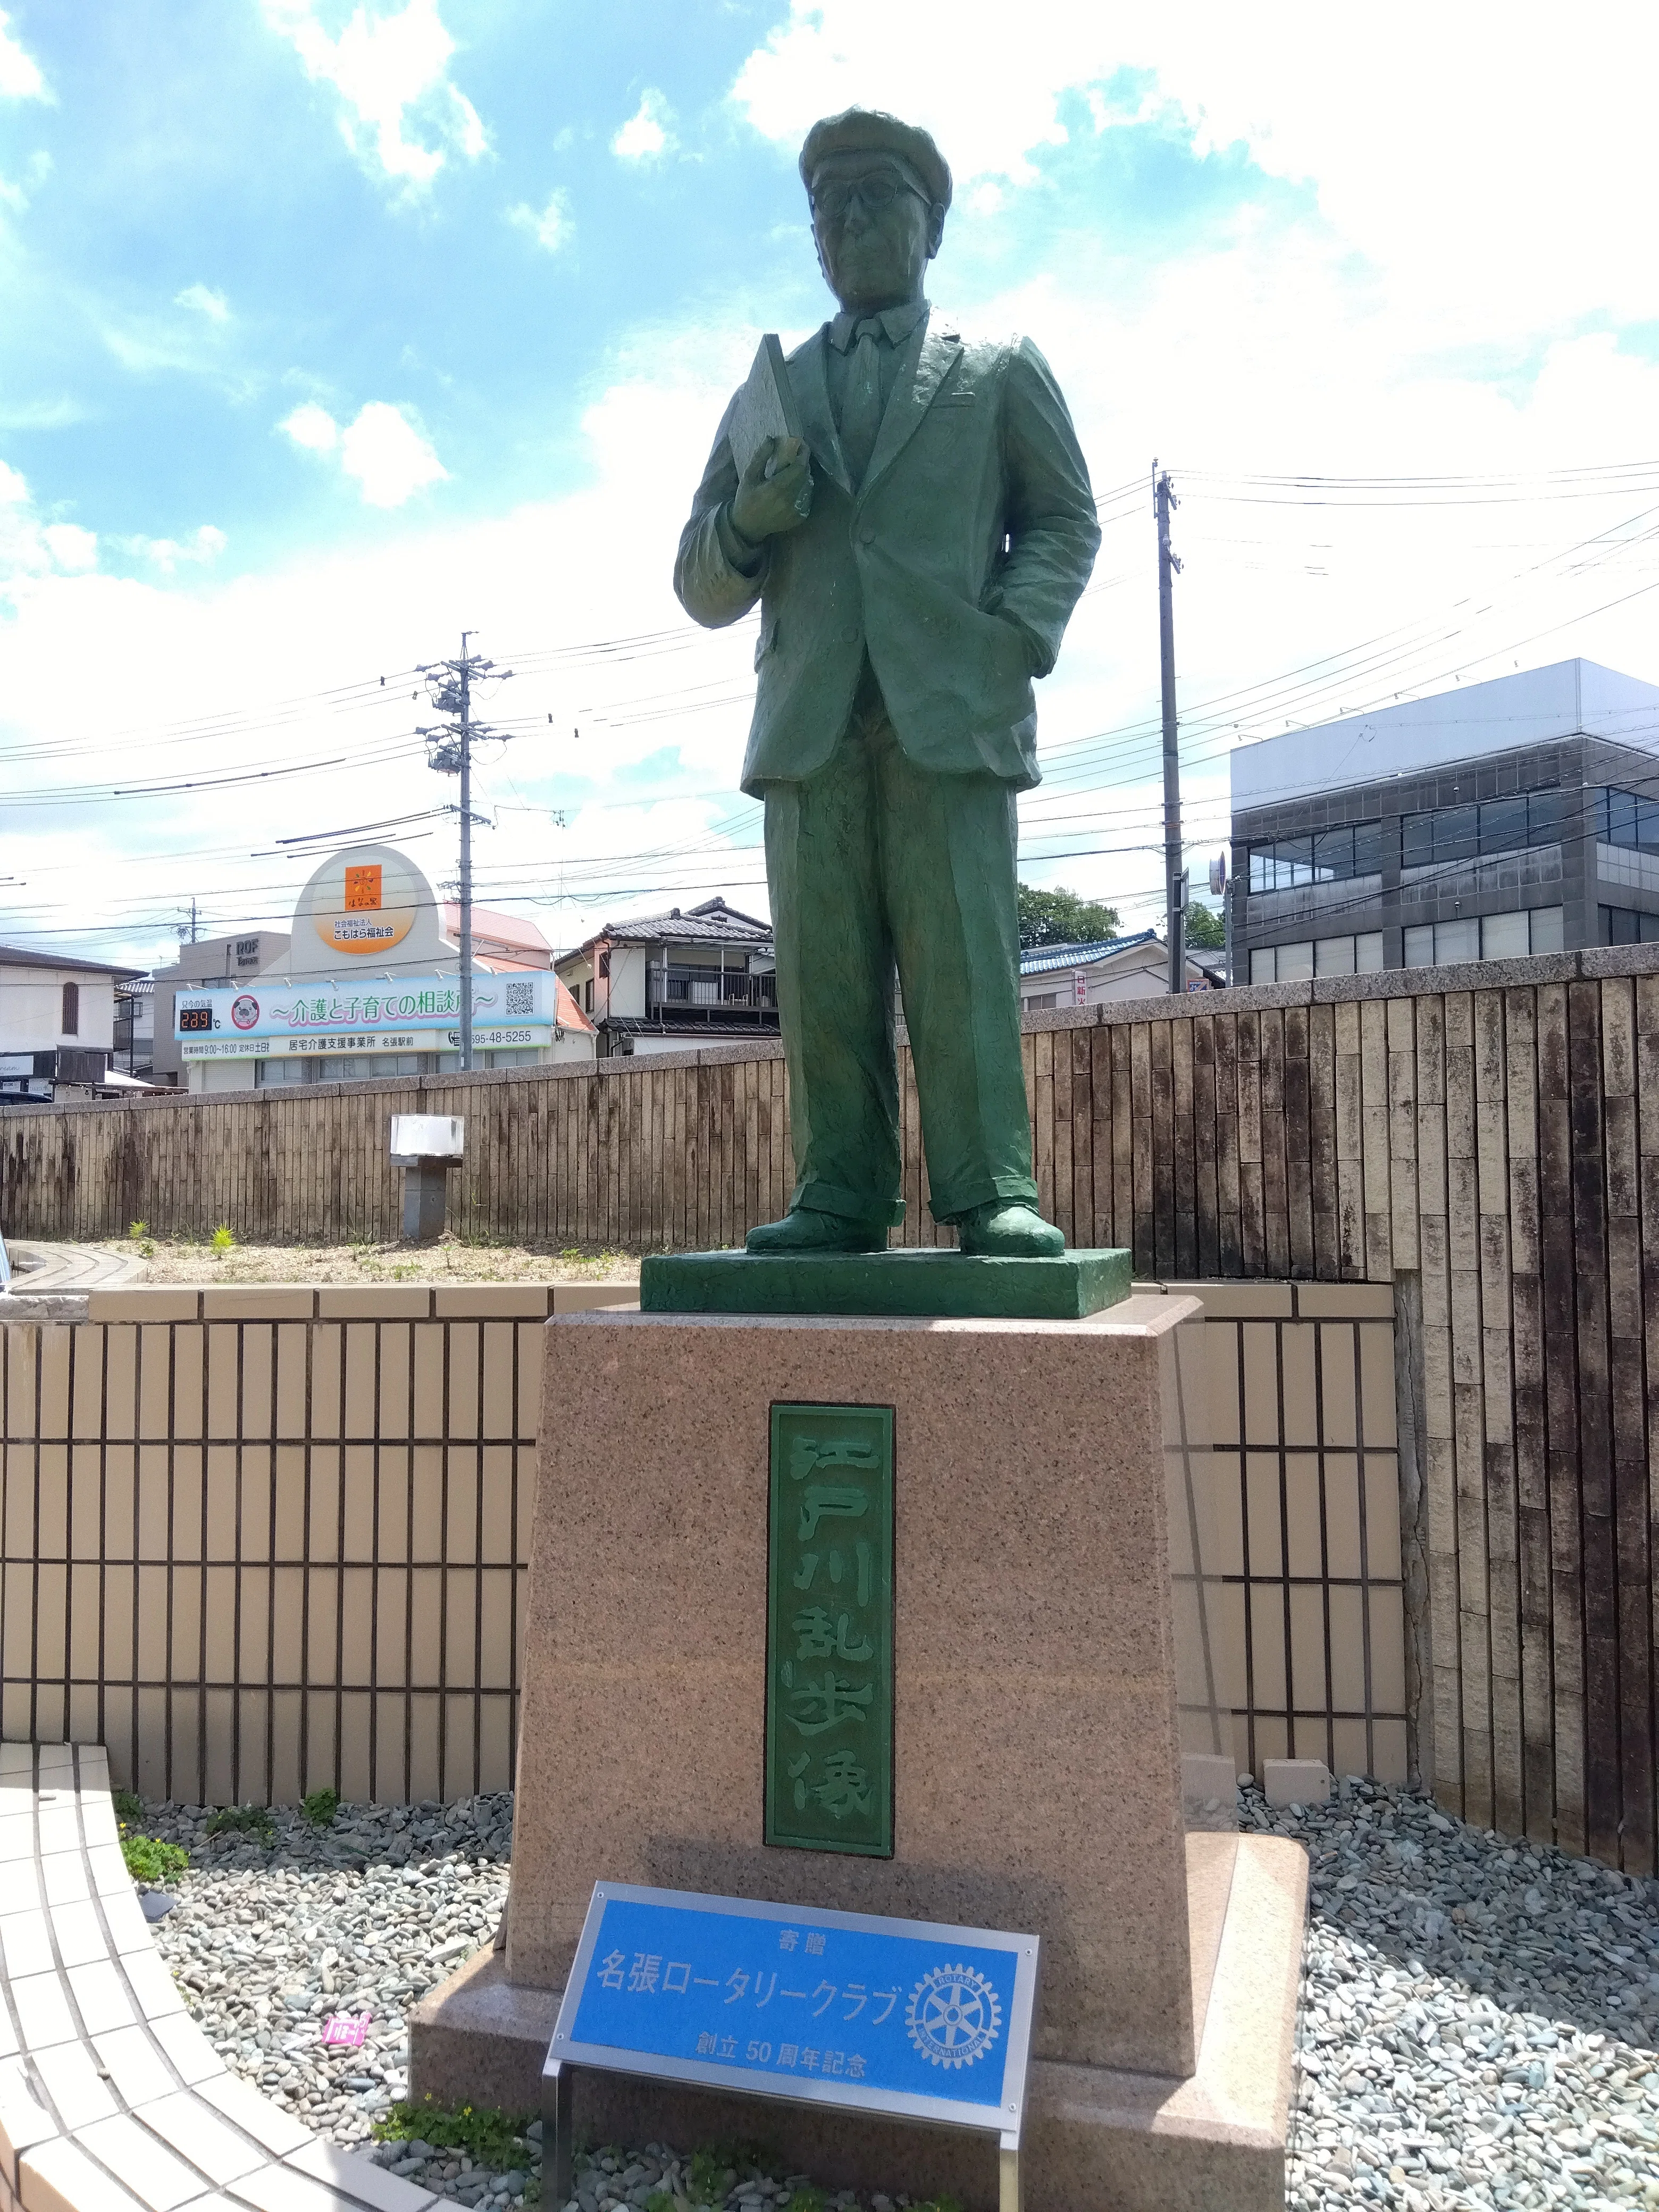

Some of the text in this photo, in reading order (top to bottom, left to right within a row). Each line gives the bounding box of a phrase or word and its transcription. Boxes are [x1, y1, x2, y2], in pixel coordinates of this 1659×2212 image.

[334, 918, 372, 928] 社会福祉法人
[334, 926, 393, 939] こもはら福祉会
[1077, 976, 1085, 1005] 日新火
[182, 999, 212, 1009] 只今の気温
[273, 990, 493, 1022] ～介護と子育ての相談～
[289, 1036, 414, 1051] 居宅介護支援事業所 名張駅前
[785, 1437, 880, 1820] 江戸川乱歩像
[597, 1949, 902, 2025] 名張ロータリークラブ
[937, 1974, 977, 1989] ROTARY
[918, 2027, 984, 2057] INTERNATIONAL
